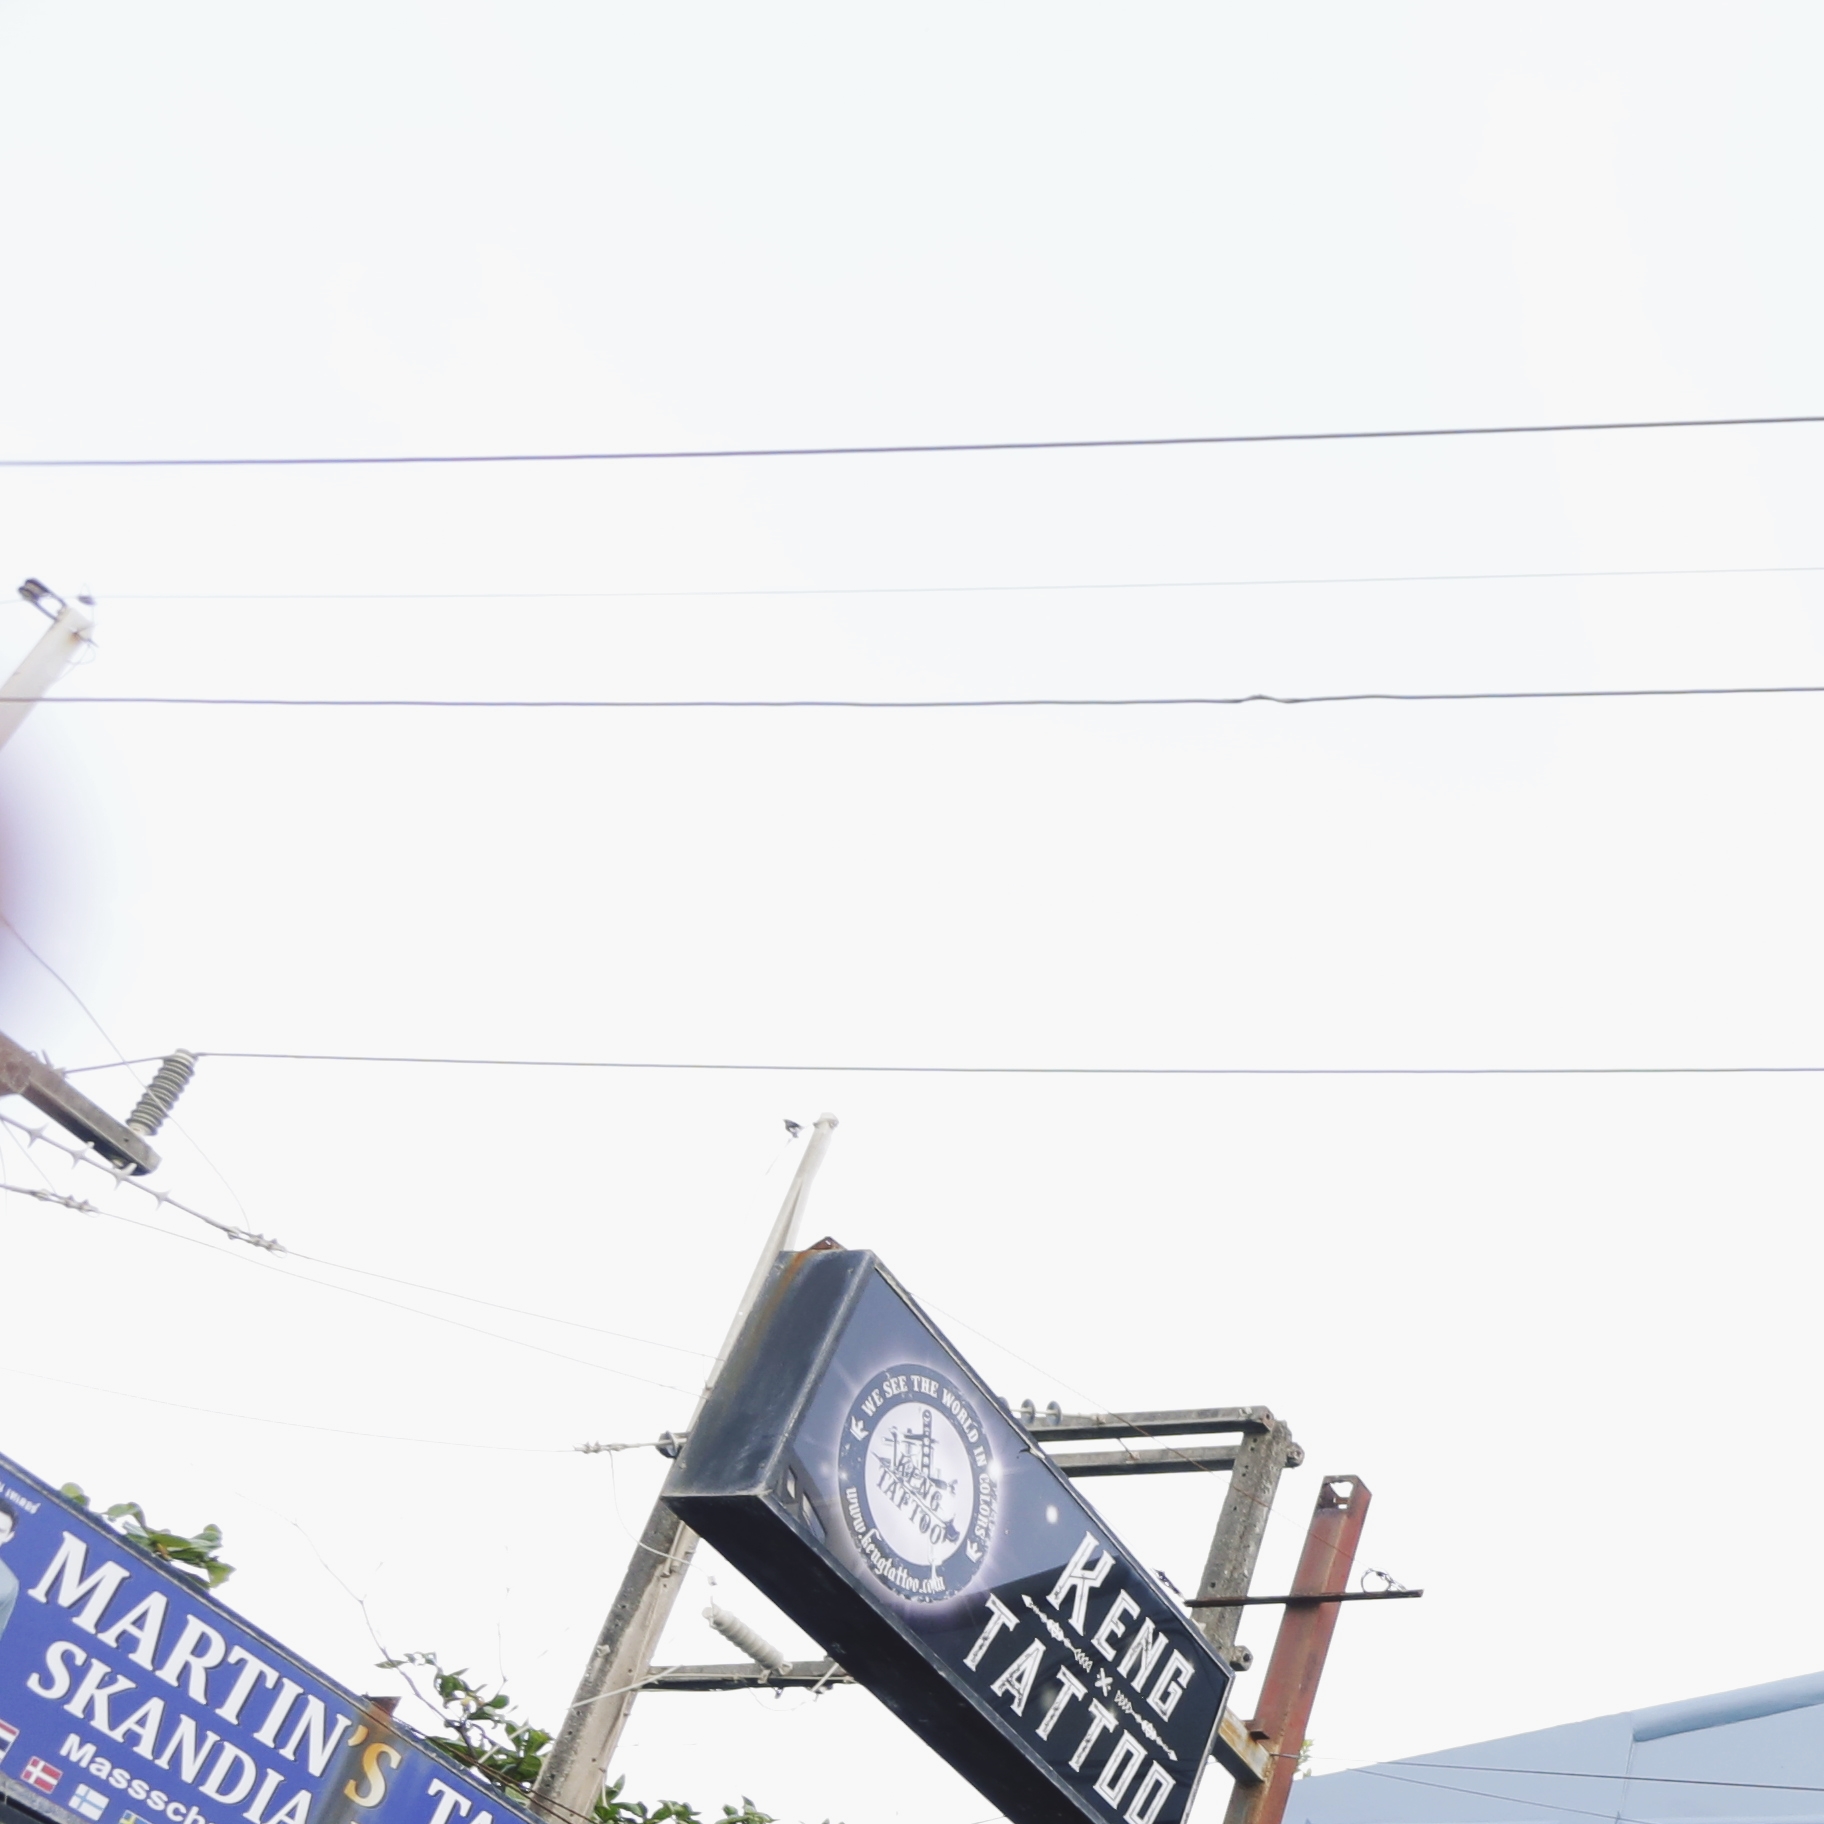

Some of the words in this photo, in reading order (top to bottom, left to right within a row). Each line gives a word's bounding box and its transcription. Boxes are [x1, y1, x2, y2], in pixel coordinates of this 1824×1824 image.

[861, 1388, 884, 1417] WE
[882, 1374, 908, 1399] SEE
[910, 1374, 939, 1399] THE
[942, 1386, 979, 1443] WORLD
[971, 1446, 988, 1468] IN
[27, 1531, 403, 1809] MARTIN'S
[1045, 1531, 1197, 1723] KENG
